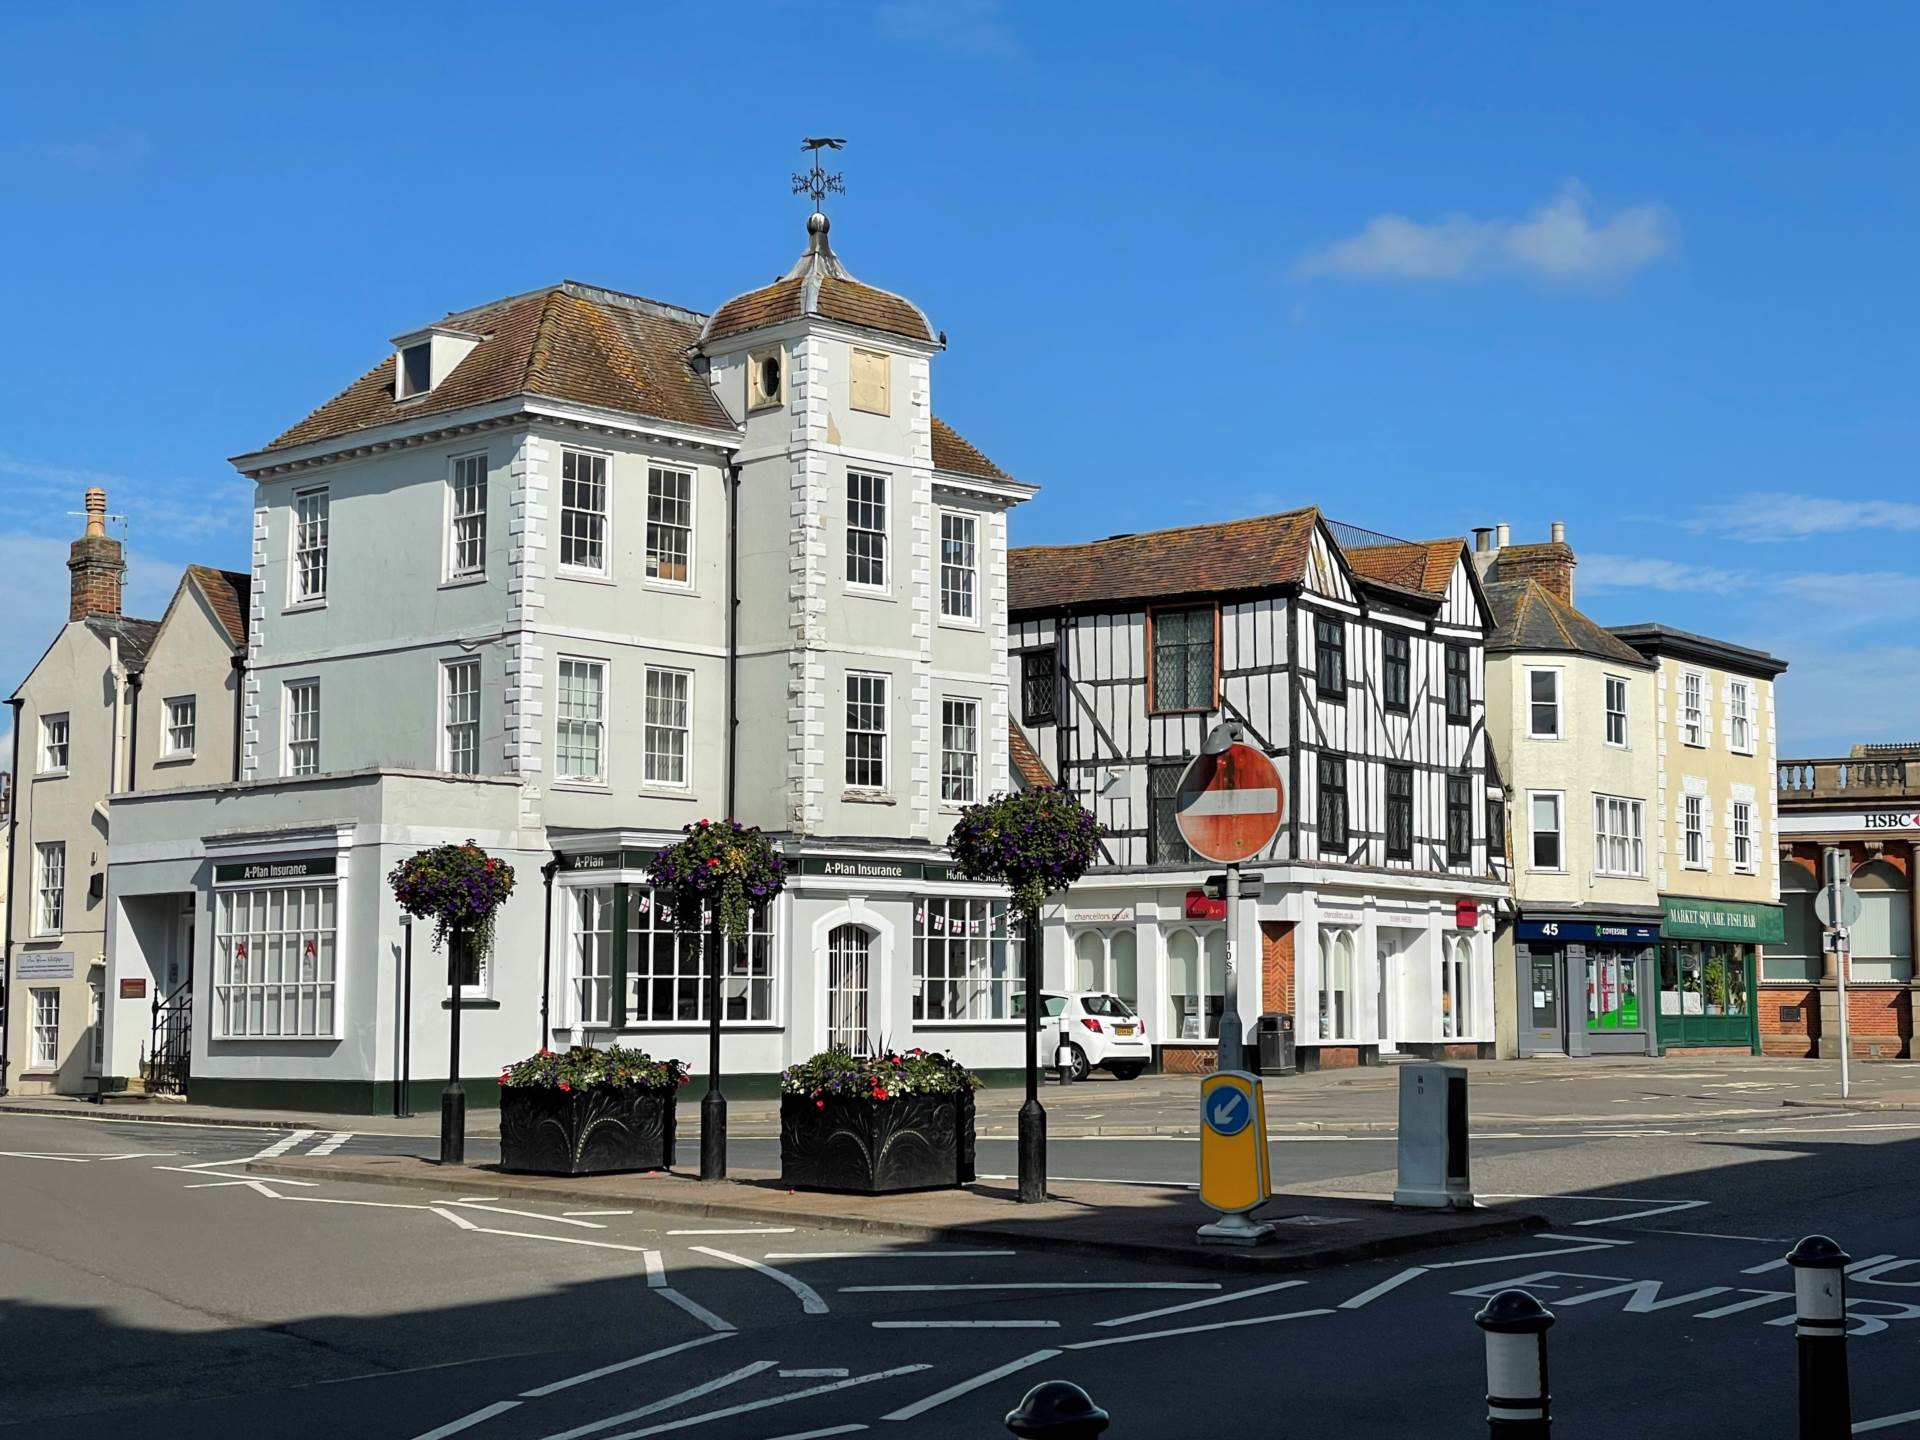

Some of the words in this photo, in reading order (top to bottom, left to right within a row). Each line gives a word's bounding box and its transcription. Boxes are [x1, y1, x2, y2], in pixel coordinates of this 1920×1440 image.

[1865, 813, 1911, 828] HSBC
[574, 855, 604, 869] A-Plan
[824, 862, 855, 874] A-Plan
[858, 863, 902, 877] Insurance
[244, 865, 269, 879] A-Plan
[270, 864, 307, 877] Insurance
[1670, 908, 1698, 924] MARKET
[1699, 911, 1726, 928] SQUARE
[1727, 913, 1742, 927] FISH
[1743, 914, 1756, 928] BAR
[1542, 922, 1559, 936] 45
